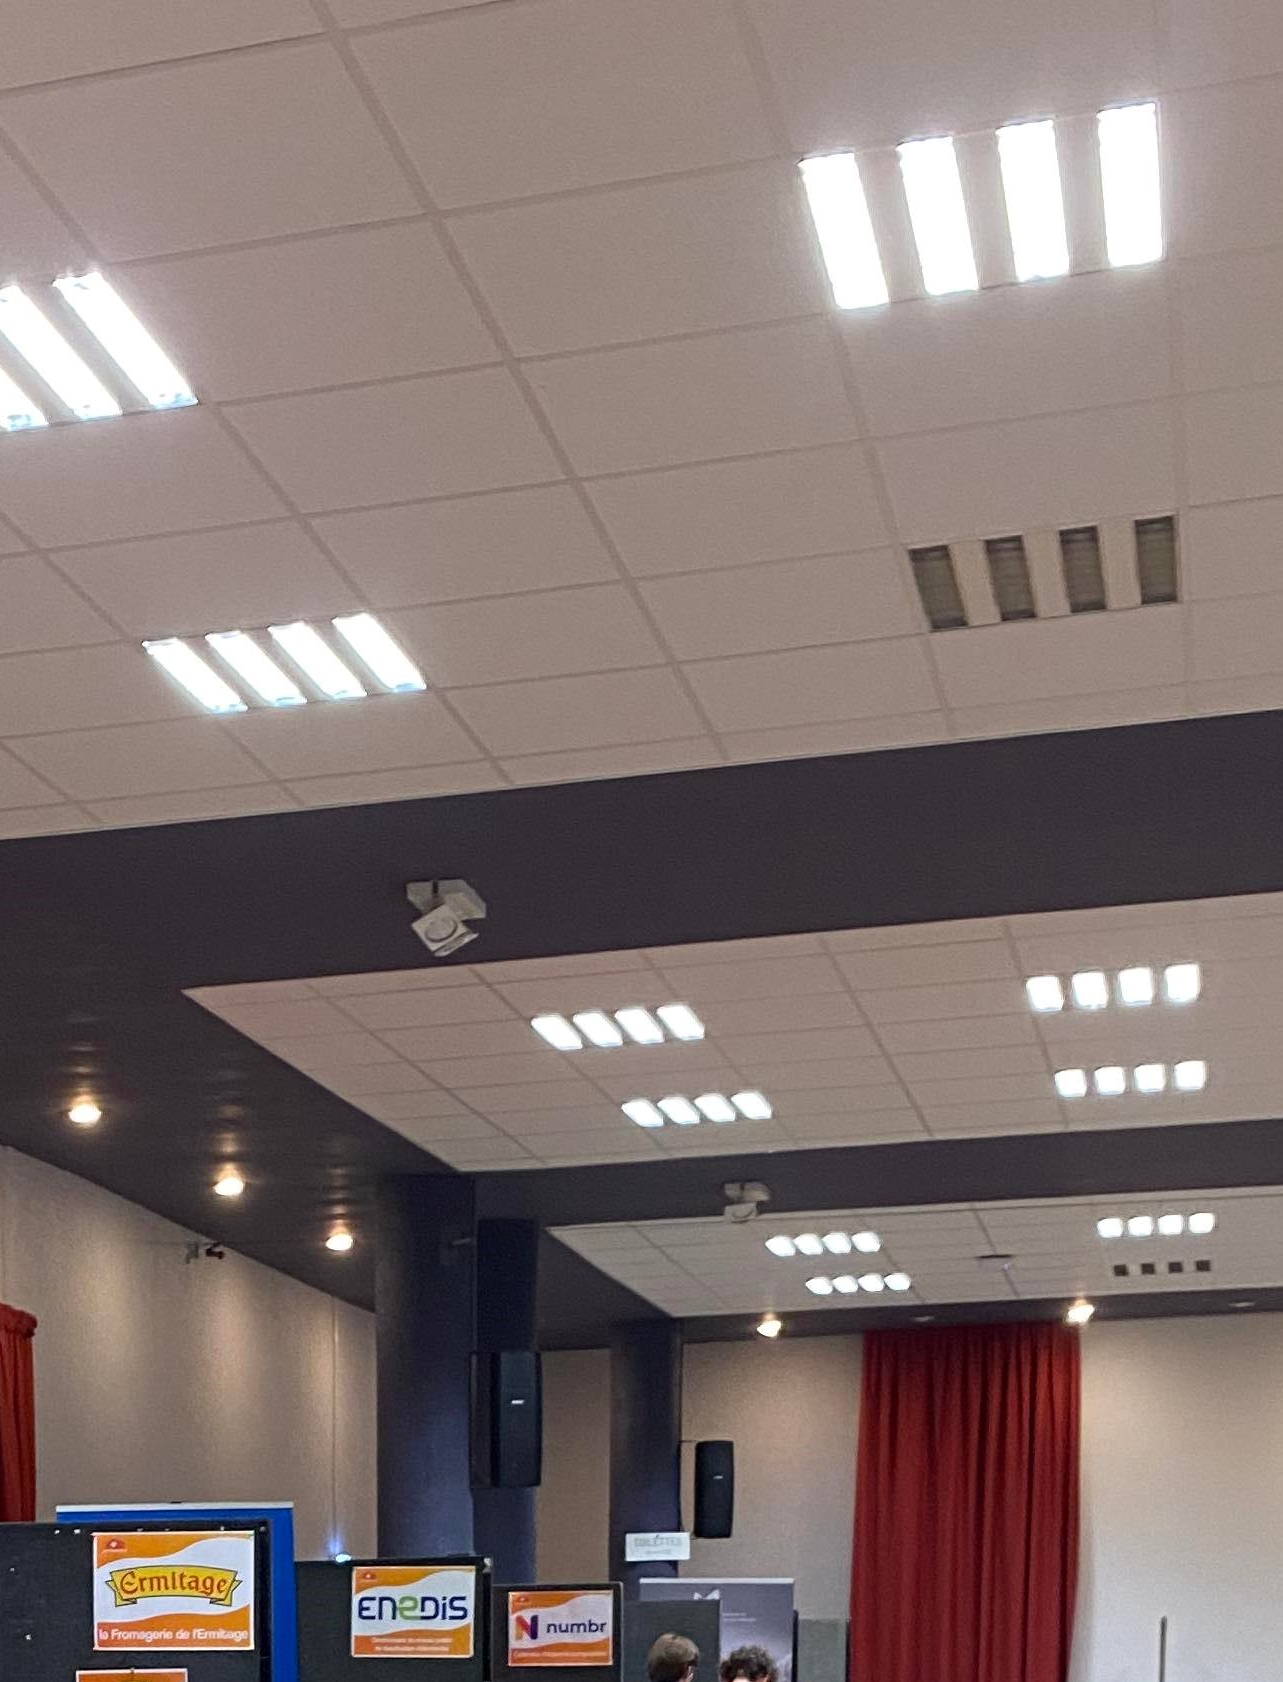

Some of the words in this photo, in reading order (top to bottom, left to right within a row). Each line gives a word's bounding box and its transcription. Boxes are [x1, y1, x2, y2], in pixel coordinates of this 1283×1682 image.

[119, 1570, 227, 1597] Ermitage
[546, 1619, 607, 1634] numbr
[99, 1628, 109, 1640] la
[111, 1628, 173, 1642] Fromagerie
[175, 1629, 190, 1640] de
[193, 1628, 248, 1643] l'Ermitage
